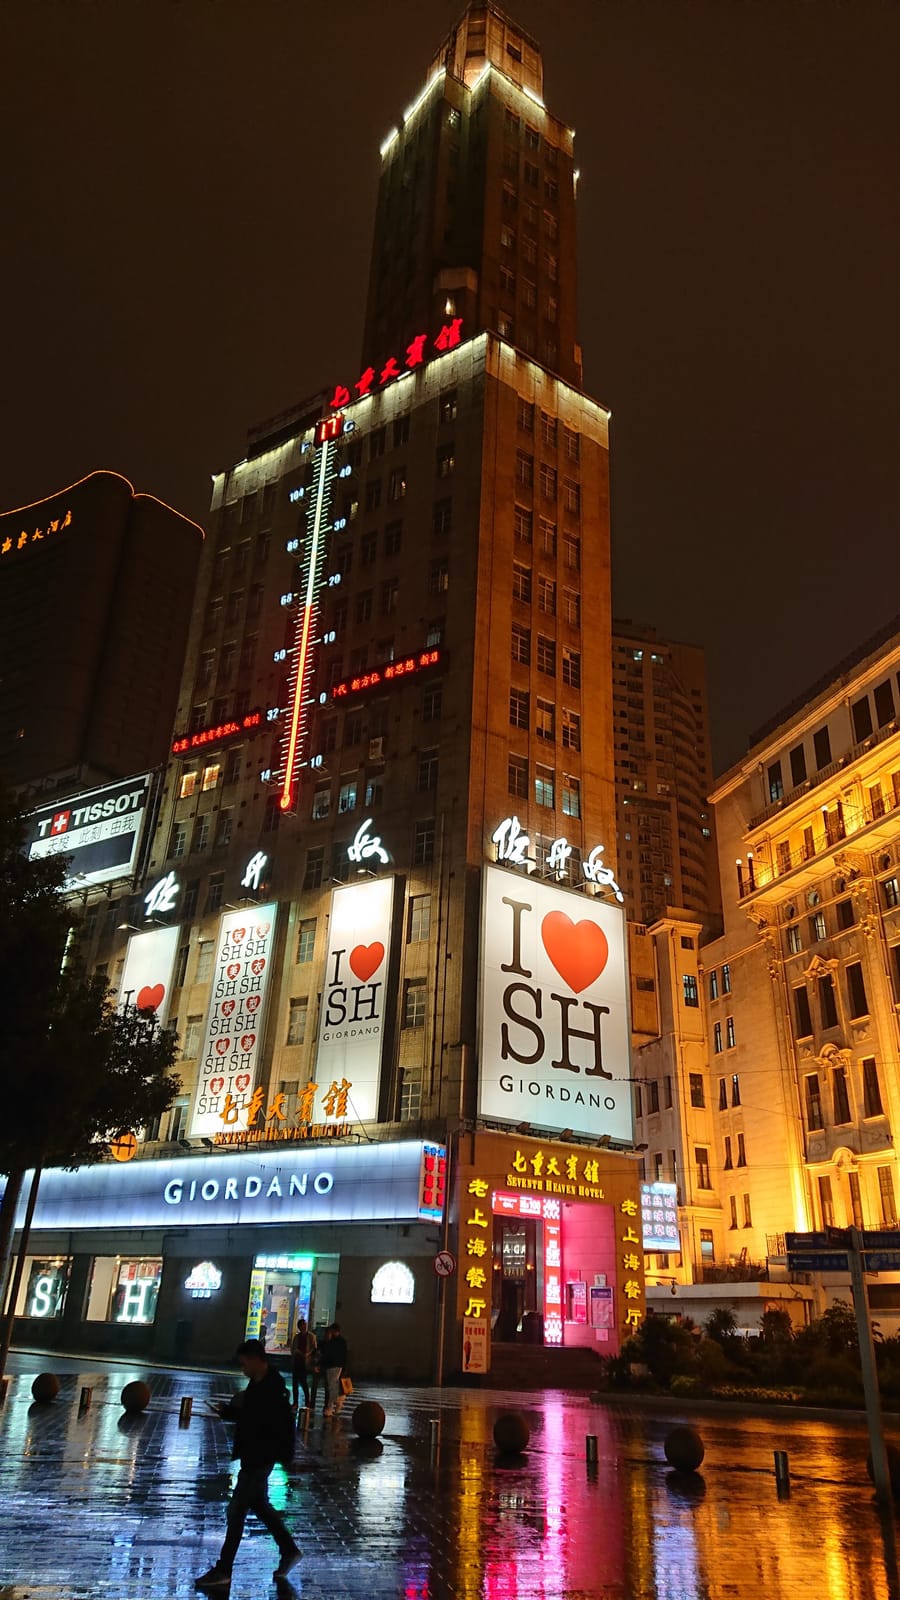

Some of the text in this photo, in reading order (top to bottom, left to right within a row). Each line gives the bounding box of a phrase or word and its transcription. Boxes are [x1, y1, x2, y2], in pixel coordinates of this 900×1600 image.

[301, 442, 312, 454] F
[339, 465, 352, 479] 40
[289, 487, 305, 503] 104
[333, 518, 347, 532] 30
[329, 573, 341, 587] 20
[323, 630, 336, 645] 10
[273, 649, 286, 663] 50
[319, 692, 327, 704] 0
[266, 707, 280, 721] 32
[310, 754, 323, 769] 10
[260, 769, 271, 783] 14
[72, 789, 144, 827] TISSOT
[224, 931, 231, 946] I
[248, 926, 256, 941] I
[501, 896, 532, 979] I
[220, 944, 243, 962] SH
[245, 939, 268, 957] SH
[218, 966, 226, 982] I
[242, 961, 250, 977] I
[328, 949, 346, 987] I
[215, 980, 238, 999] SH
[239, 976, 263, 994] SH
[213, 1003, 221, 1019] I
[237, 999, 245, 1015] I
[325, 982, 382, 1027] SH
[209, 1018, 232, 1036] SH
[234, 1013, 258, 1032] SH
[322, 1026, 380, 1042] GIORDANO
[501, 982, 613, 1081] SH
[207, 1040, 215, 1057] I
[232, 1037, 240, 1054] I
[203, 1056, 227, 1075] SH
[229, 1053, 253, 1072] SH
[201, 1080, 209, 1096] I
[226, 1076, 234, 1093] I
[499, 1074, 616, 1111] GIORDANO
[197, 1096, 221, 1115] SH
[212, 1123, 351, 1145] SEVENTH HEAVEN HOTEL
[164, 1172, 334, 1204] GIORDANO
[506, 1174, 605, 1199] SEVENTH HEAVEN HOTEL
[465, 1178, 489, 1319] 老上海餐厅
[621, 1199, 642, 1326] 老上海餐厅
[117, 1280, 152, 1323] H
